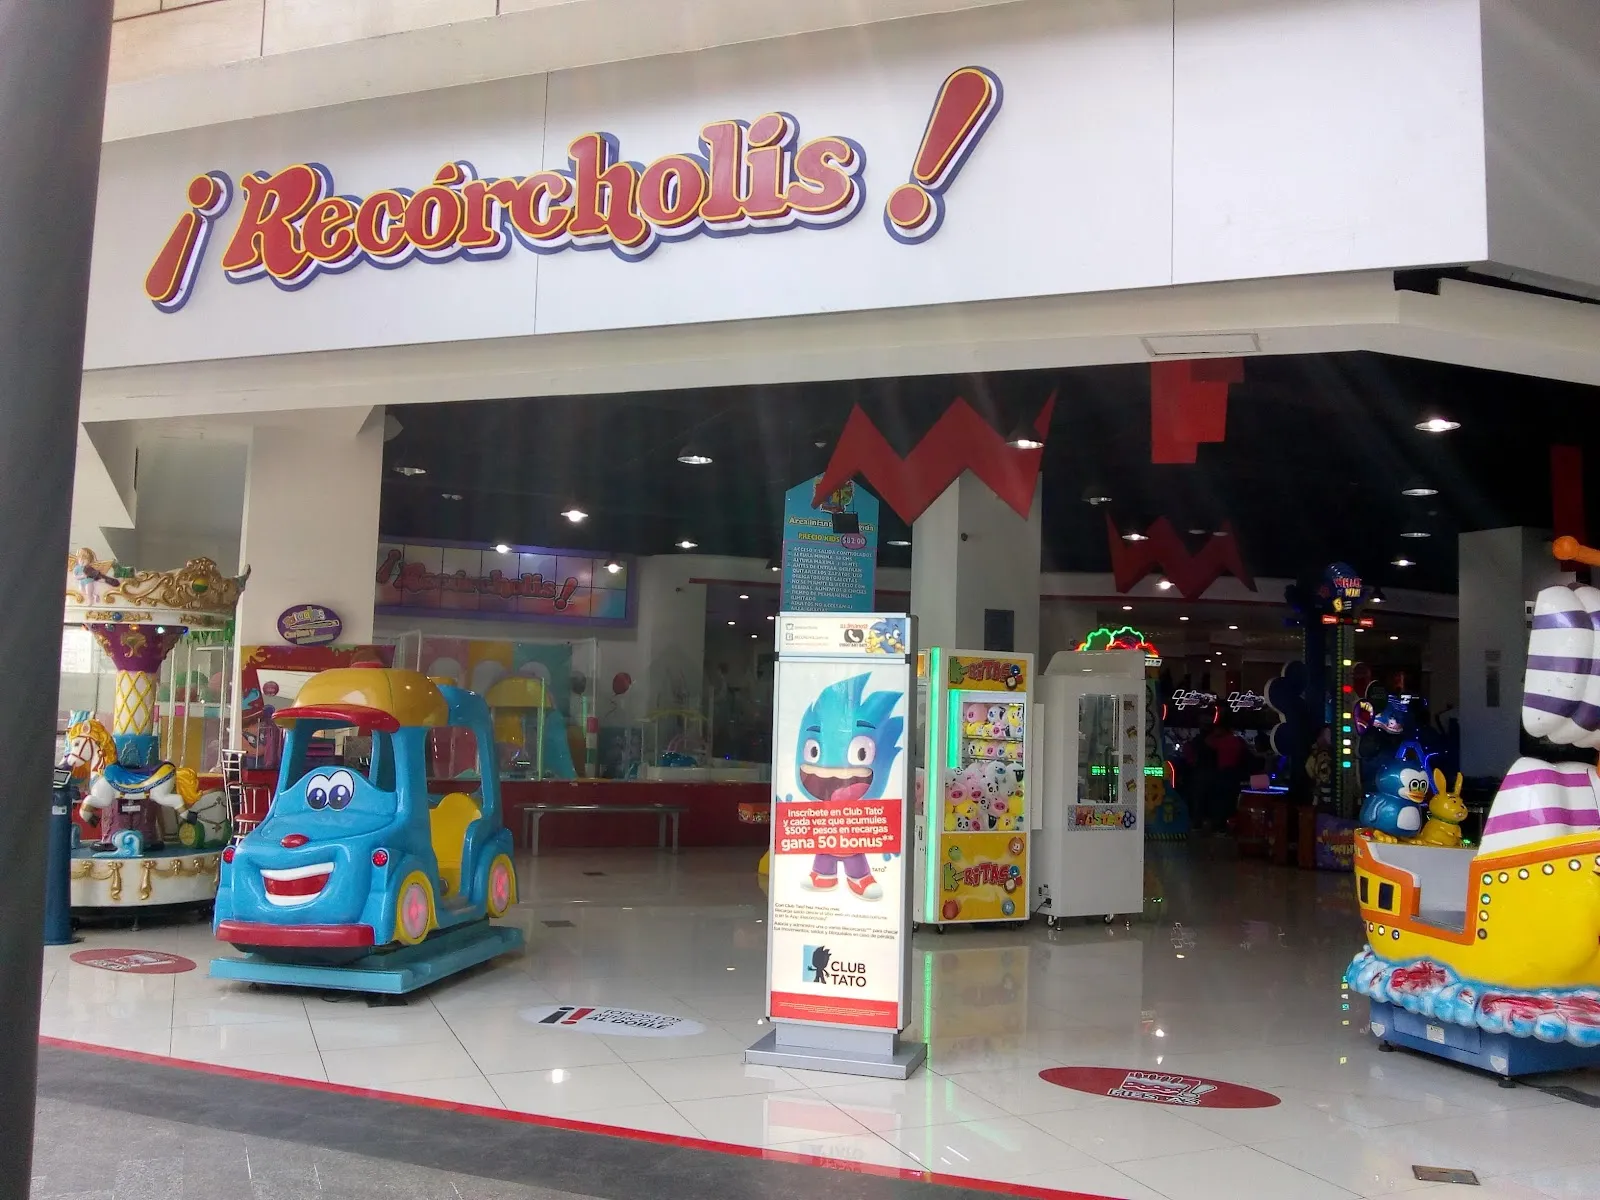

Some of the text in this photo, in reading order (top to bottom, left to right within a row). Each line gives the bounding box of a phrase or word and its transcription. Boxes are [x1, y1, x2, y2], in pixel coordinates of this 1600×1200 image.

[842, 808, 862, 816] Club
[783, 820, 788, 828] y
[790, 818, 810, 826] cada
[828, 818, 845, 827] que
[846, 816, 887, 825] acumules
[812, 827, 838, 836] pesos
[852, 826, 888, 835] recargas
[781, 838, 814, 851] gana
[818, 836, 837, 848] 50
[831, 961, 866, 974] CLUB
[831, 974, 867, 988] TATO
